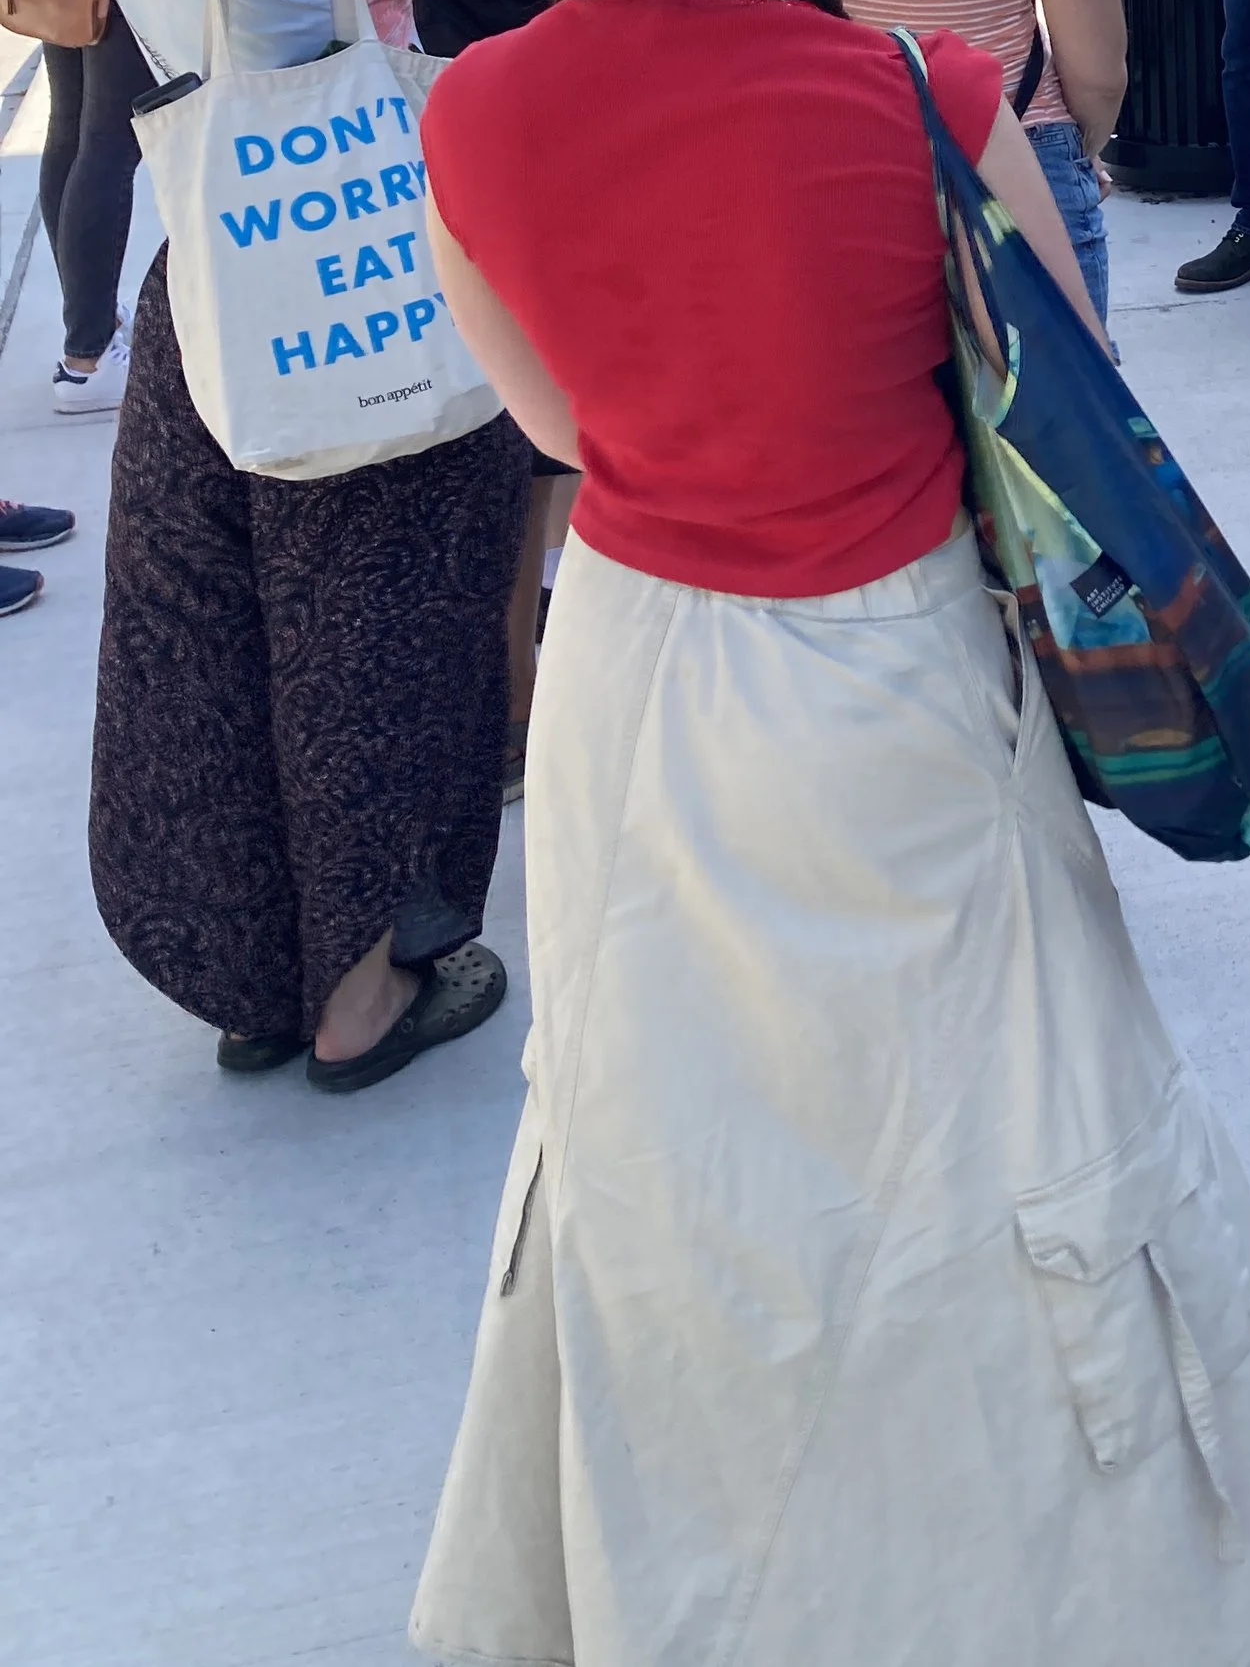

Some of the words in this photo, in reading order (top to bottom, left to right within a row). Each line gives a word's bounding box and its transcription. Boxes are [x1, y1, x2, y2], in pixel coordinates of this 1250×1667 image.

[234, 97, 410, 176] DON'T
[315, 231, 417, 298] EAT
[357, 396, 386, 409] bon
[386, 378, 434, 403] appétit
